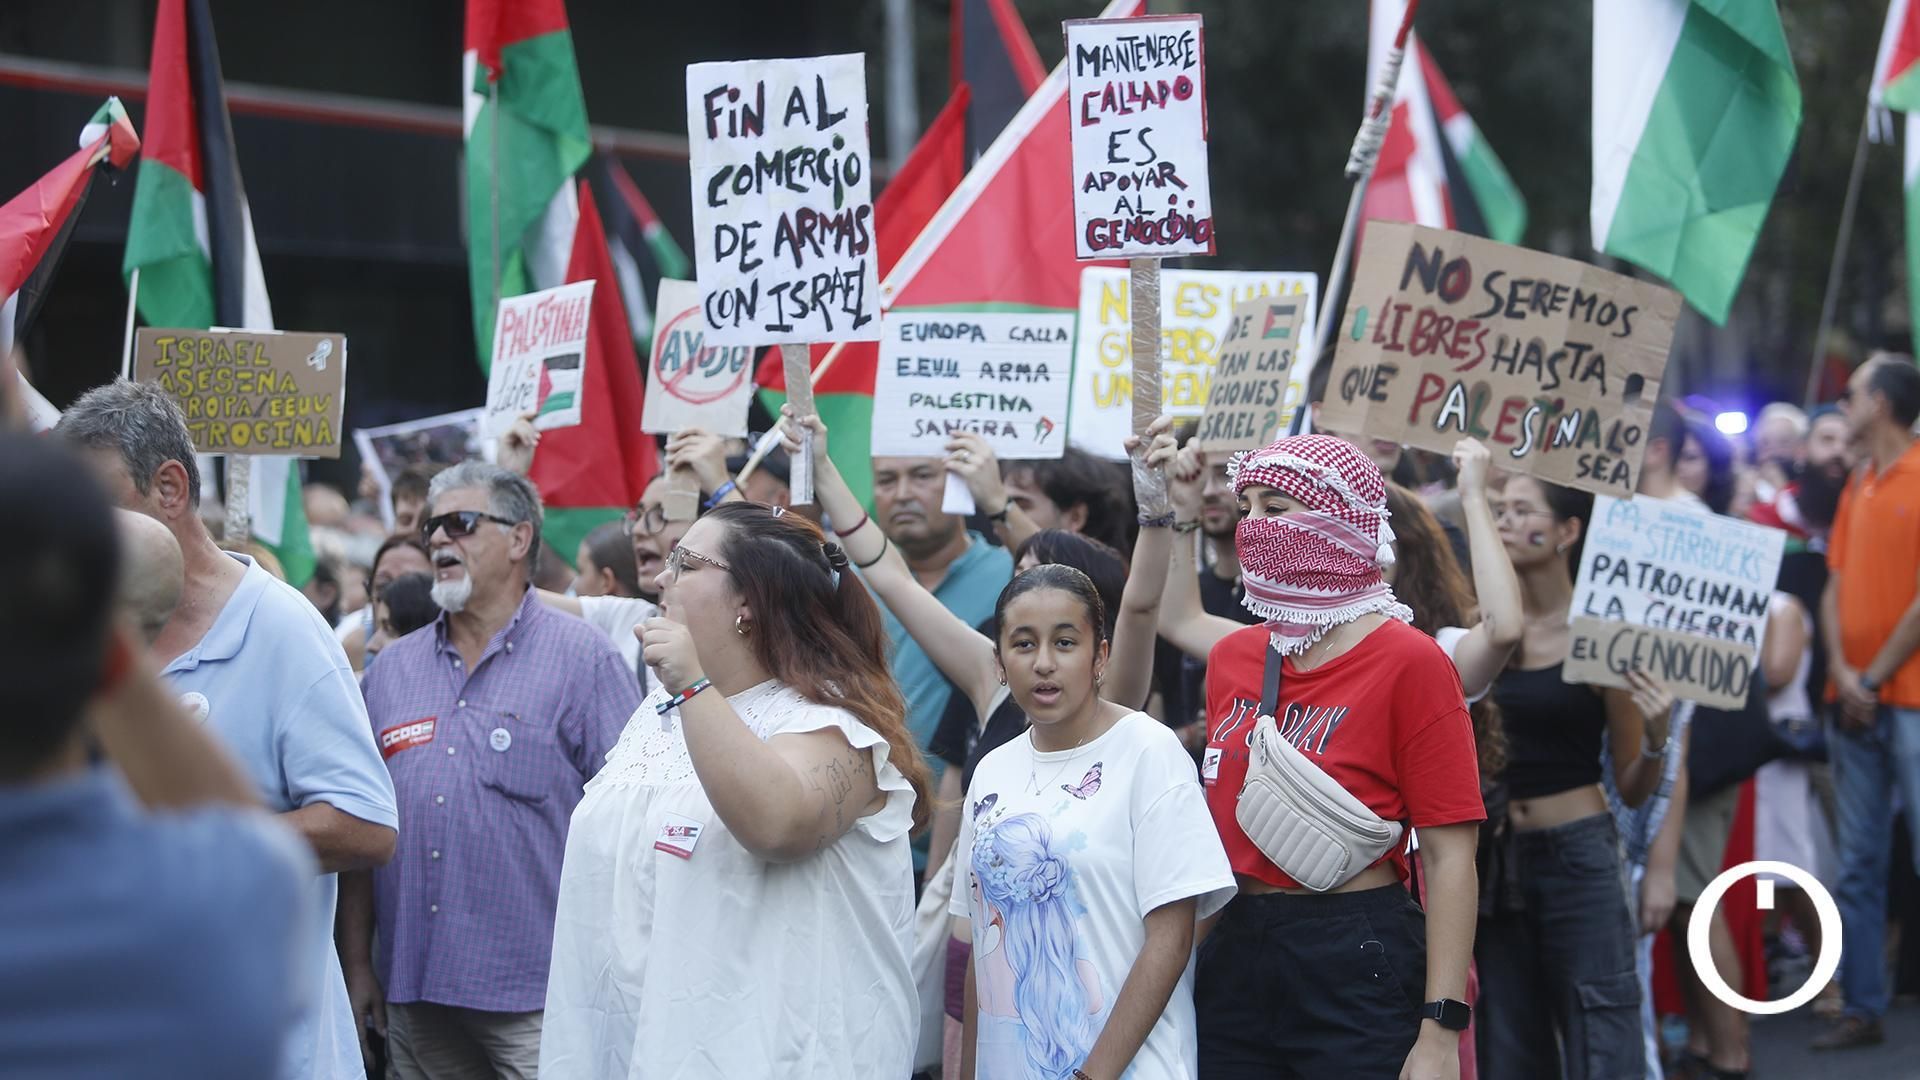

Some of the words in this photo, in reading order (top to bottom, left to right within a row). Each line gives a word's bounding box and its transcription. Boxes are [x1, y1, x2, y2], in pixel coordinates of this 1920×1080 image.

[1077, 30, 1196, 77] MANTENERSE
[783, 74, 848, 131] AL
[1081, 75, 1193, 127] CALLADO
[1108, 127, 1157, 166] ES
[1084, 161, 1188, 193] APOYAR
[1114, 194, 1155, 216] AL
[715, 220, 763, 273] DE
[773, 204, 872, 269] ARMAS
[705, 278, 759, 329] CON
[765, 259, 872, 333] ISRAEL
[1174, 281, 1219, 319] ES
[1400, 241, 1472, 303] NO
[1469, 270, 1639, 338] SEREMOS
[498, 293, 586, 362] PALESTINA
[900, 323, 985, 343] EUROPA
[1009, 326, 1068, 341] CALLA
[1371, 296, 1491, 372] LIBRES
[1490, 336, 1607, 396] HASTA
[154, 335, 271, 368] ISRAEL
[1255, 349, 1291, 371] LAS
[160, 367, 298, 397] ASESINA
[979, 362, 1050, 383] ARMA
[909, 393, 1033, 412] PALESTINA
[1210, 379, 1280, 408] CIONES
[1342, 364, 1399, 405] QUE
[1606, 418, 1642, 455] LO
[187, 417, 334, 448] TROCINA
[911, 418, 1018, 439] SANGRA
[1576, 453, 1631, 489] SEA
[1643, 522, 1766, 583] STARBUCKS
[1590, 554, 1769, 617] PATROCINAN
[1584, 592, 1625, 622] LA
[1644, 601, 1758, 652] GUERRA
[1571, 637, 1599, 660] EL
[1606, 628, 1749, 698] GENOCIDIO
